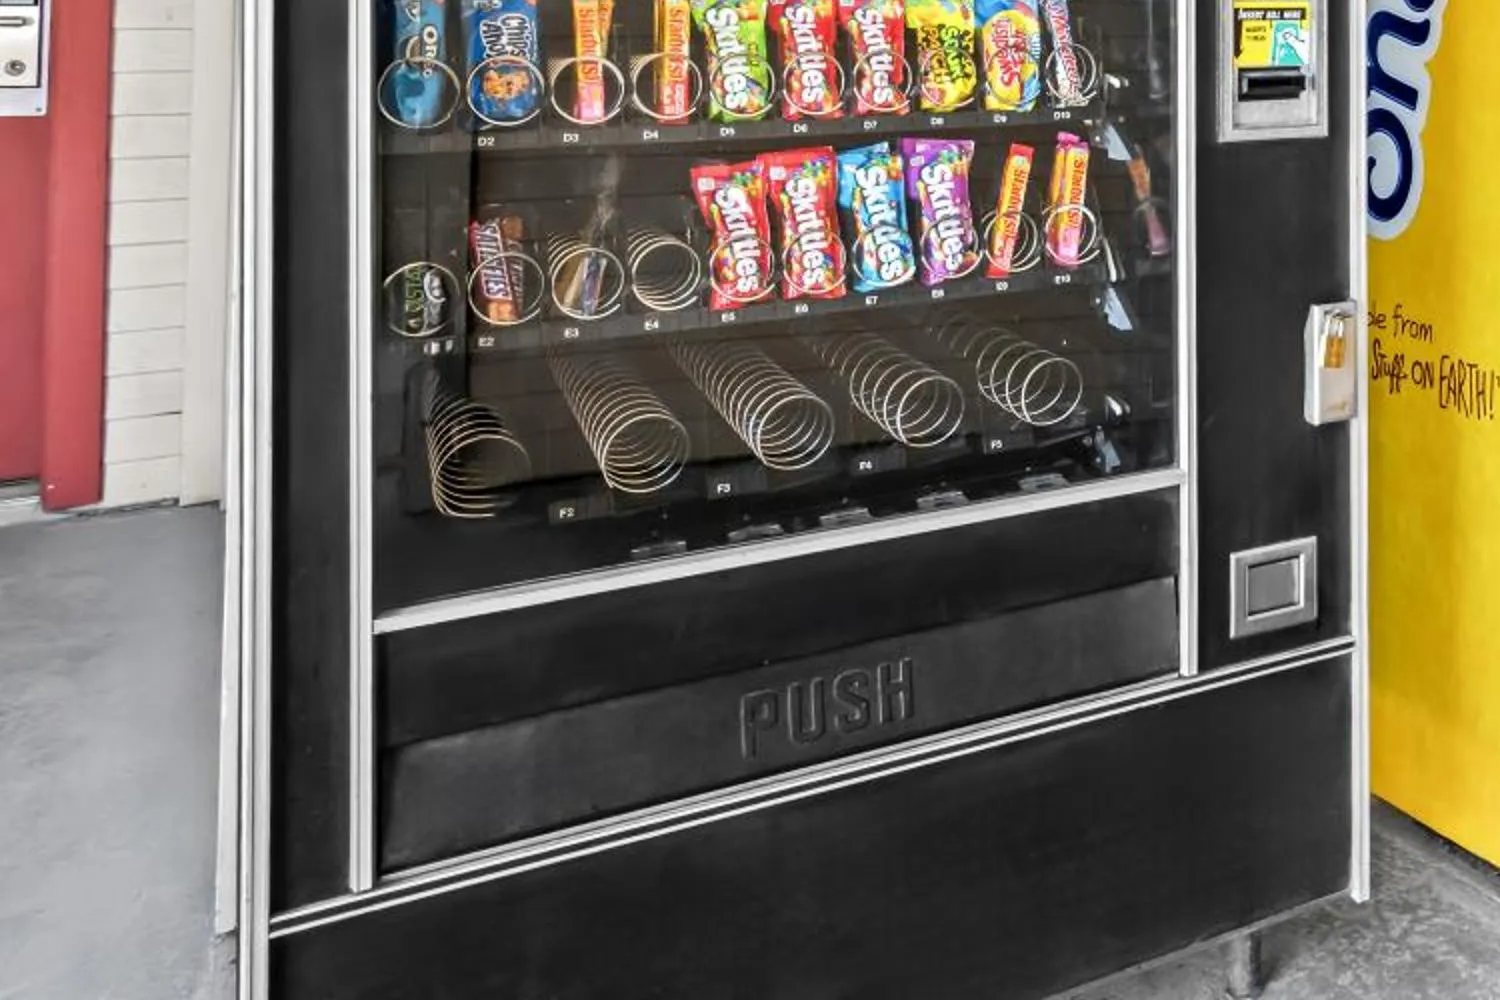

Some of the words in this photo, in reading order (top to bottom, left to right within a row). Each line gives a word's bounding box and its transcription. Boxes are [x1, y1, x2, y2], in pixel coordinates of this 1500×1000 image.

[499, 13, 530, 58] Chips
[704, 6, 749, 109] Skittles
[784, 5, 827, 104] Skittles
[855, 7, 894, 105] Skittles
[715, 185, 761, 293] Skittles
[785, 177, 828, 286] Skittles
[855, 166, 902, 281] Skittles
[920, 164, 964, 270] Skittles
[1067, 158, 1086, 227] Starbust
[1371, 337, 1407, 395] Stuff
[1411, 359, 1435, 388] ON
[1392, 303, 1433, 343] from
[738, 657, 914, 758] PUSH
